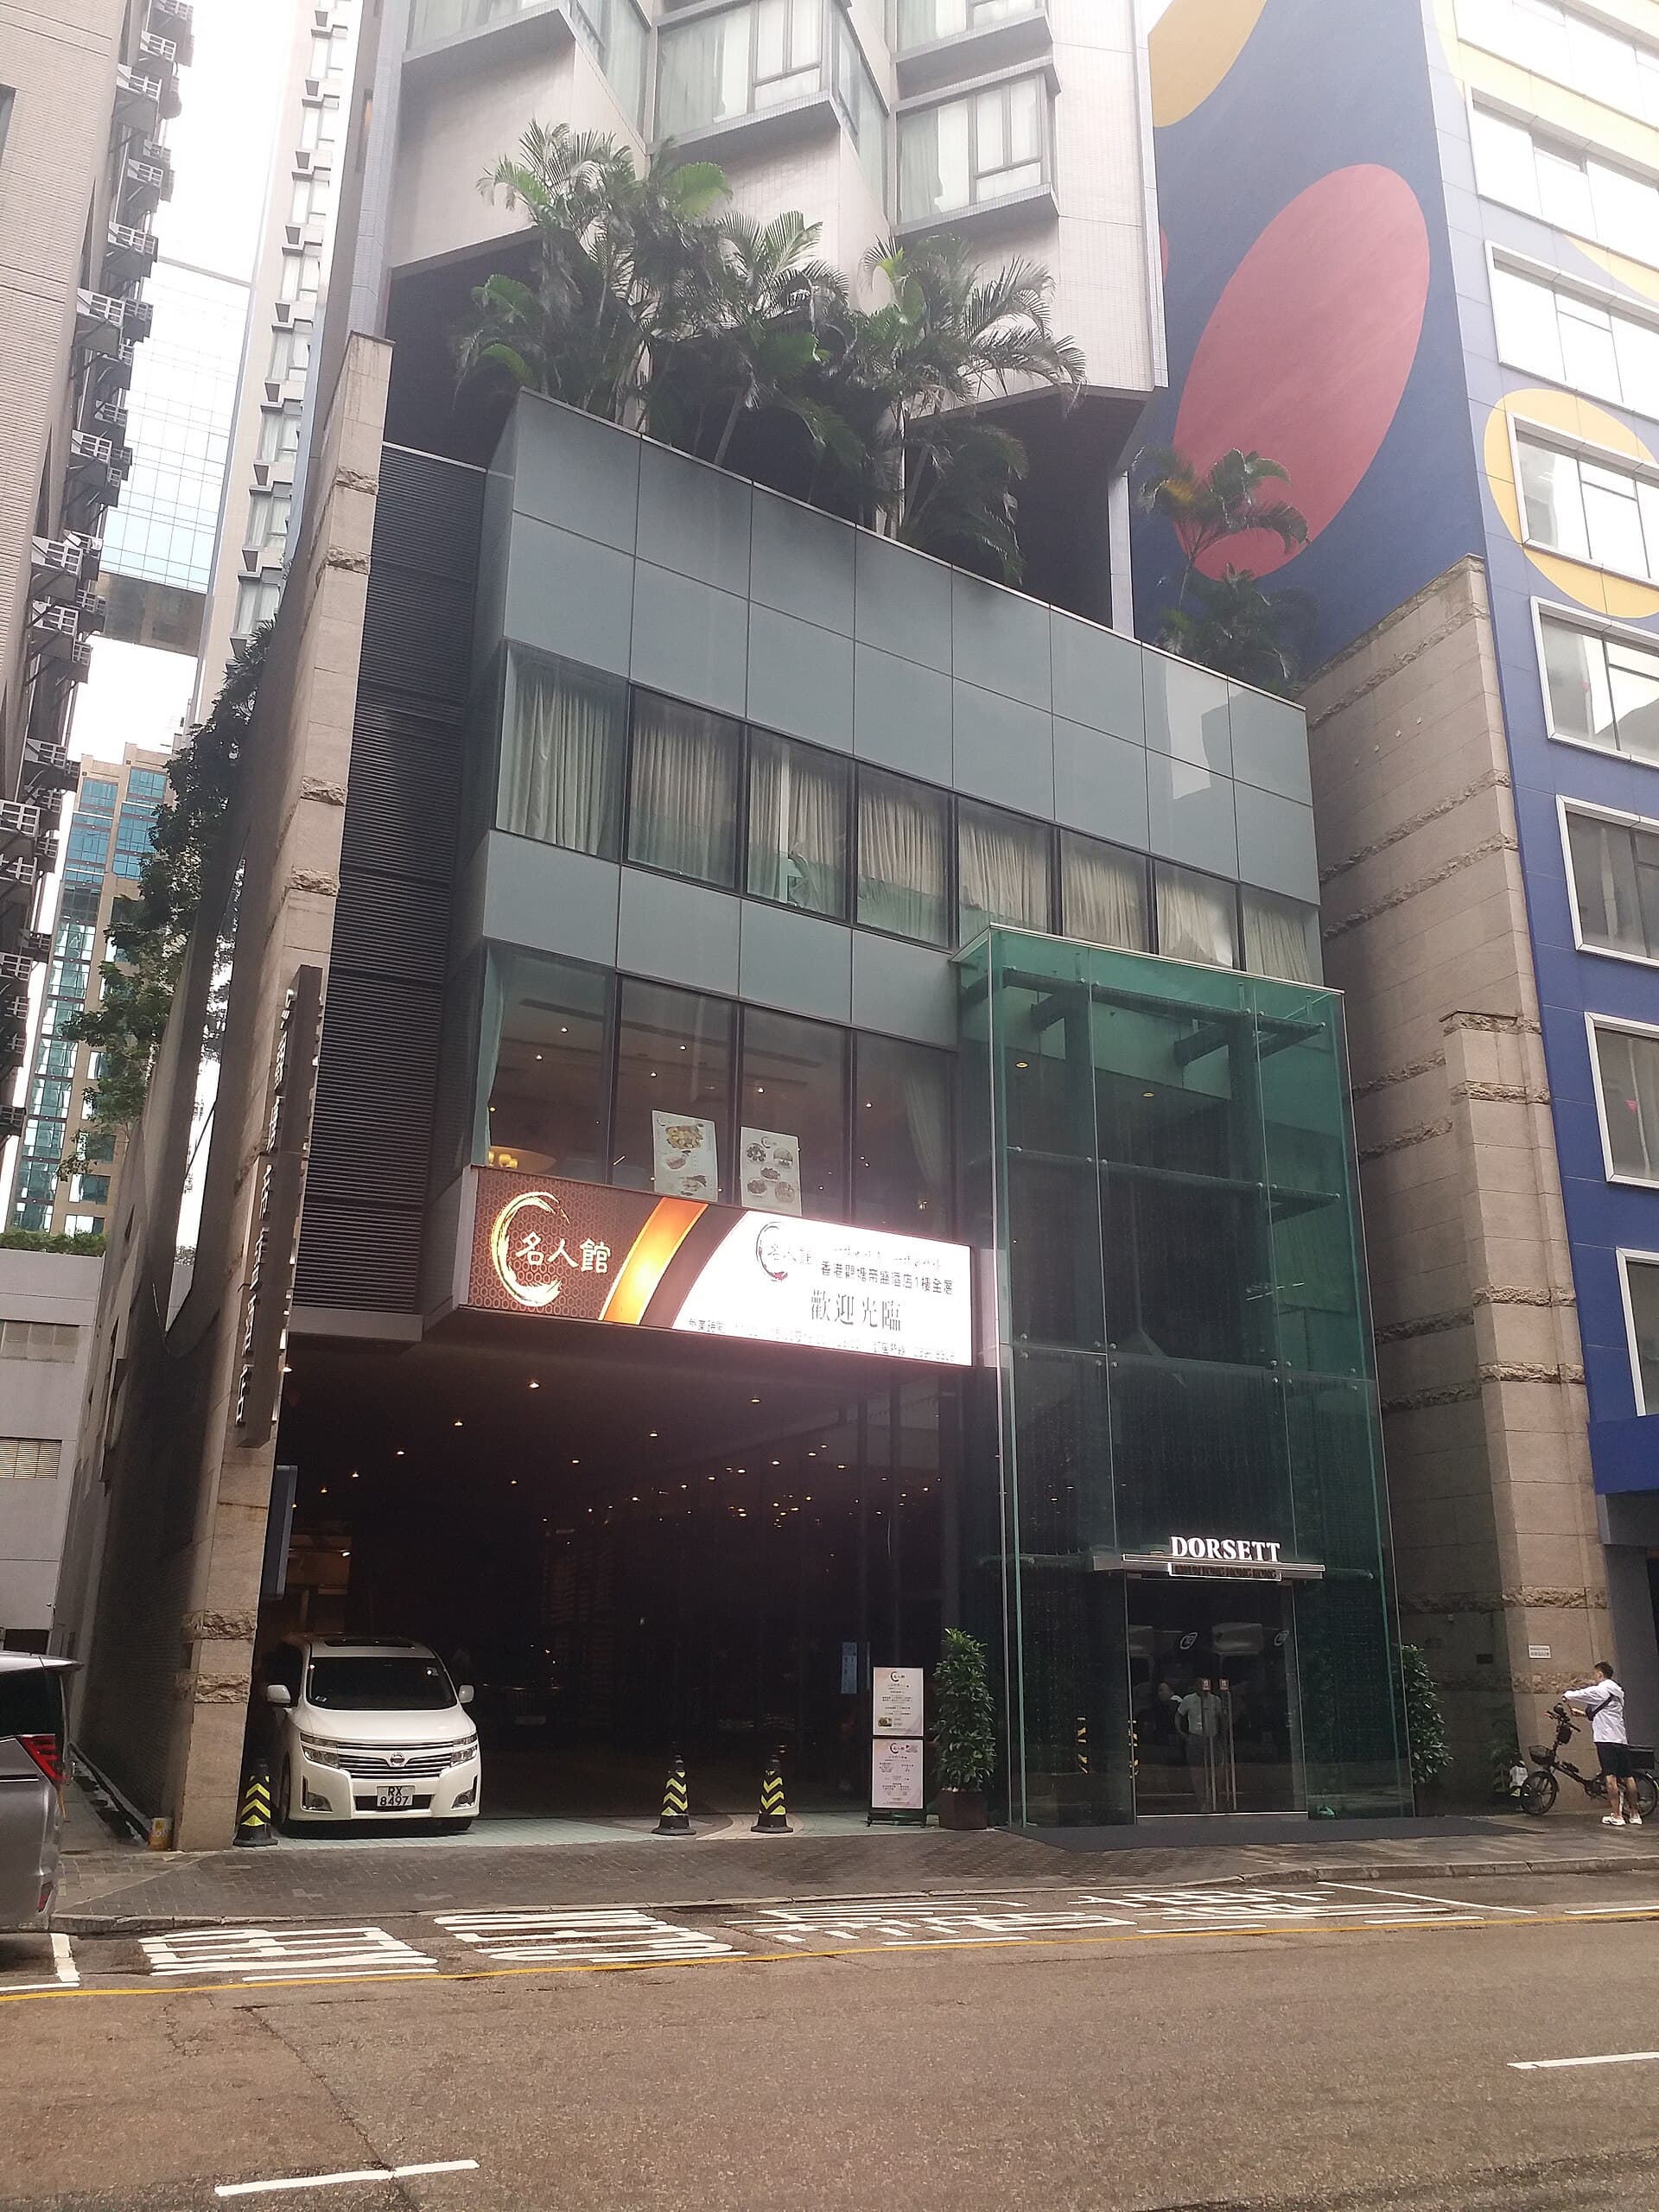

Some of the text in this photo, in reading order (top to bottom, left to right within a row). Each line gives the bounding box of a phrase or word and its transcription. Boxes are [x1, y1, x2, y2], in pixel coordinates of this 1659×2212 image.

[516, 1232, 612, 1274] 名人館
[810, 1288, 902, 1332] 歡迎光臨
[1170, 1535, 1281, 1562] DORSETT
[379, 1796, 410, 1806] 8497
[387, 1786, 403, 1796] RX
[138, 1928, 439, 1976] KEEP
[434, 1910, 734, 1961] CLEAR
